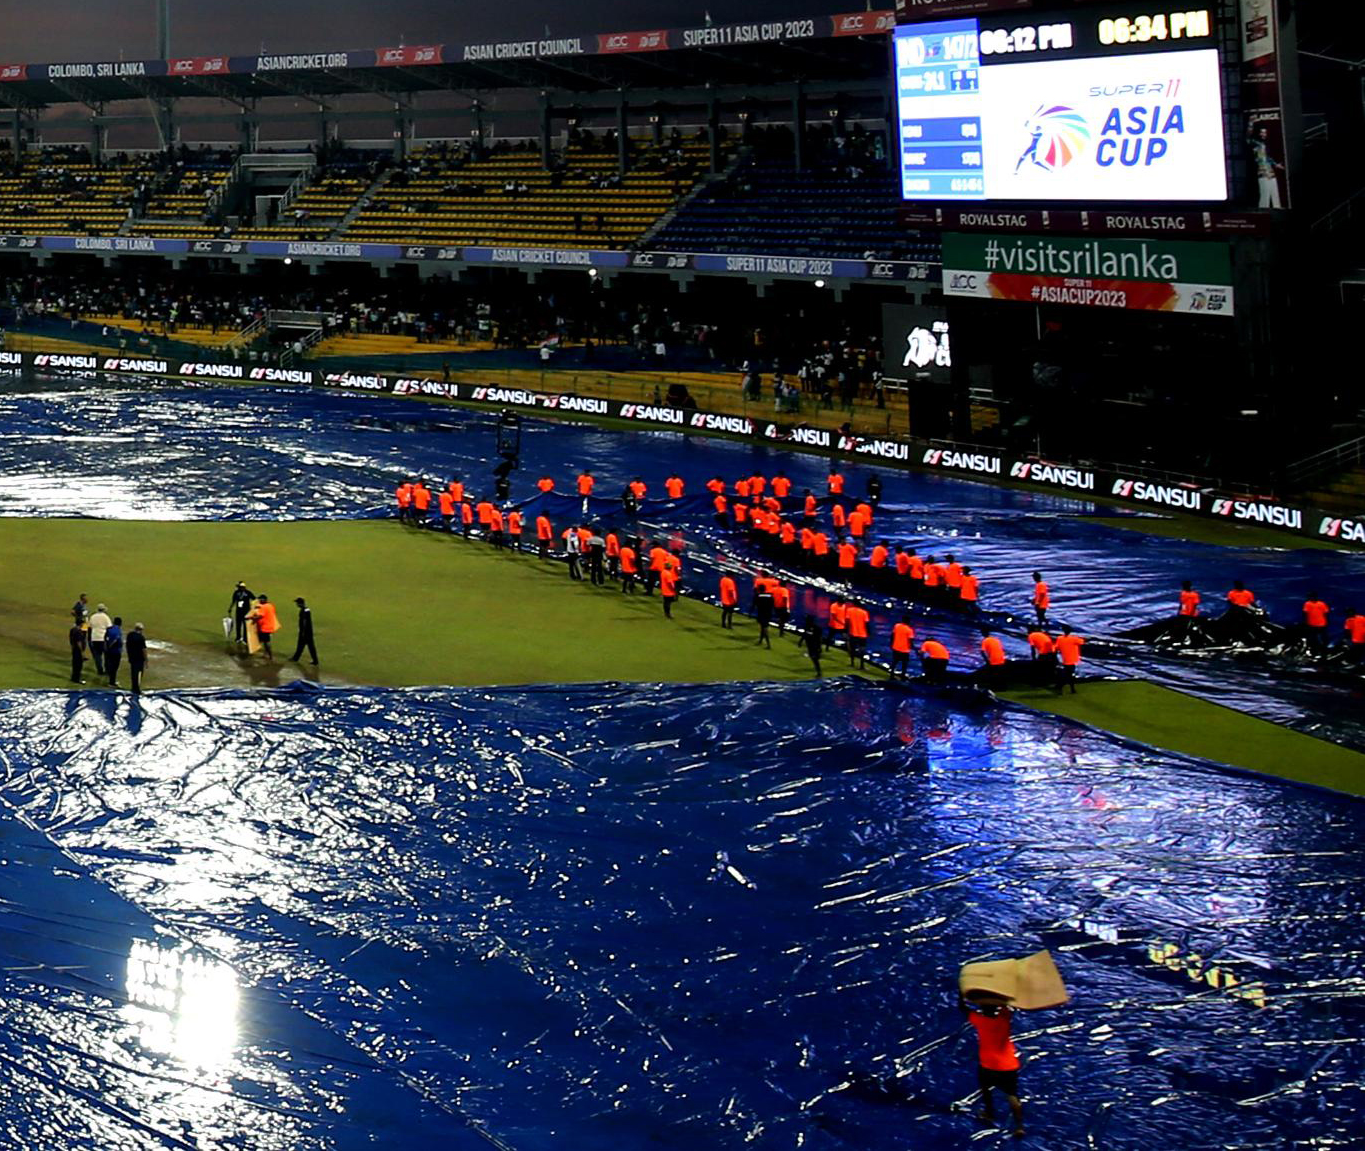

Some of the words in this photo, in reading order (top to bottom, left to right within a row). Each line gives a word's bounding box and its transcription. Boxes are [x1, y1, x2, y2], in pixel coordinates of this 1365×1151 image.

[734, 25, 760, 42] ASIA
[761, 23, 783, 40] CUP
[785, 19, 815, 38] 2023
[1169, 10, 1210, 39] PM
[1039, 23, 1073, 50] PM
[463, 45, 495, 60] ASIAN
[496, 41, 538, 58] CRICKET
[538, 38, 584, 56] COUNCIL
[48, 64, 96, 78] COLOMBO,
[97, 63, 113, 76] SRI
[114, 62, 145, 76] LANKA
[256, 53, 348, 70] ASIANCRICKET.ORG
[1101, 105, 1185, 136] ASIA
[1096, 137, 1168, 167] CUP
[115, 239, 128, 249] SRI
[129, 239, 155, 251] LANKA
[492, 249, 517, 262] ASIAN
[519, 250, 555, 263] CRICKET
[556, 252, 591, 265] COUNCIL
[984, 239, 1178, 280] #visitsrilanka
[766, 259, 788, 273] ASIA
[789, 259, 807, 273] CUP
[808, 260, 832, 275] 2023
[950, 273, 977, 290] ACC
[1031, 286, 1126, 308] #ASIACUP2023
[49, 354, 96, 369] SANSUI
[120, 358, 167, 373] SANSUI
[195, 363, 243, 378] SANSUI
[265, 367, 312, 384] SANSUI
[487, 387, 536, 406] SANSUI
[559, 395, 607, 414] SANSUI
[636, 405, 683, 424] SANSUI
[941, 450, 1000, 474] SANSUI
[1031, 464, 1094, 489] SANSUI
[1133, 481, 1201, 510] SANSUI
[1234, 501, 1302, 529] SANSUI
